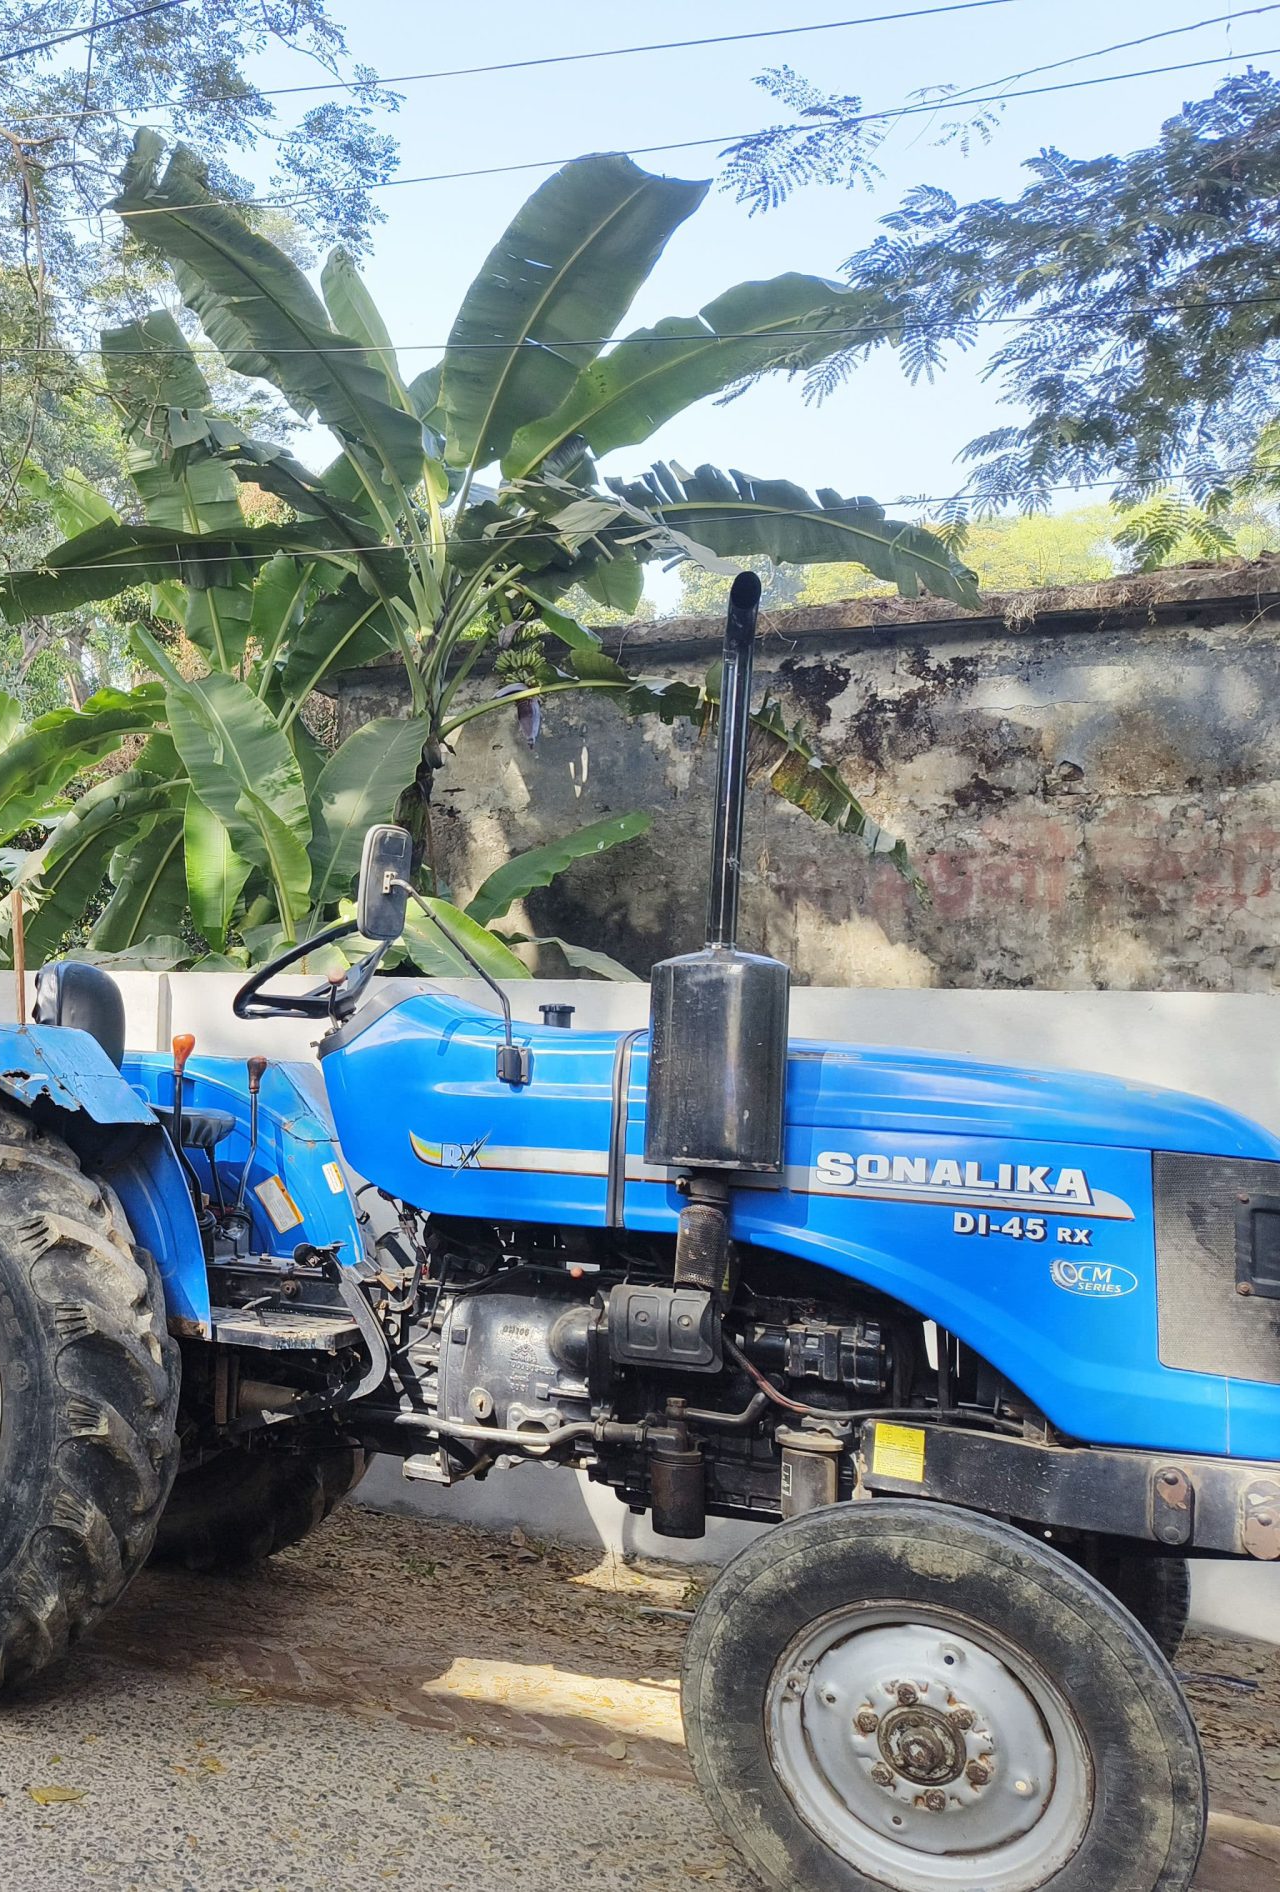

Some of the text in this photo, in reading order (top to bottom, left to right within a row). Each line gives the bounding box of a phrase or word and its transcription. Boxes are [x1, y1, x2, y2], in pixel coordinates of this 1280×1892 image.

[441, 1137, 485, 1171] RX
[816, 1151, 1093, 1204] SONALIKA
[953, 1211, 1092, 1245] DI-45 RX
[1077, 1281, 1122, 1293] SERIES
[1078, 1265, 1112, 1283] CM
